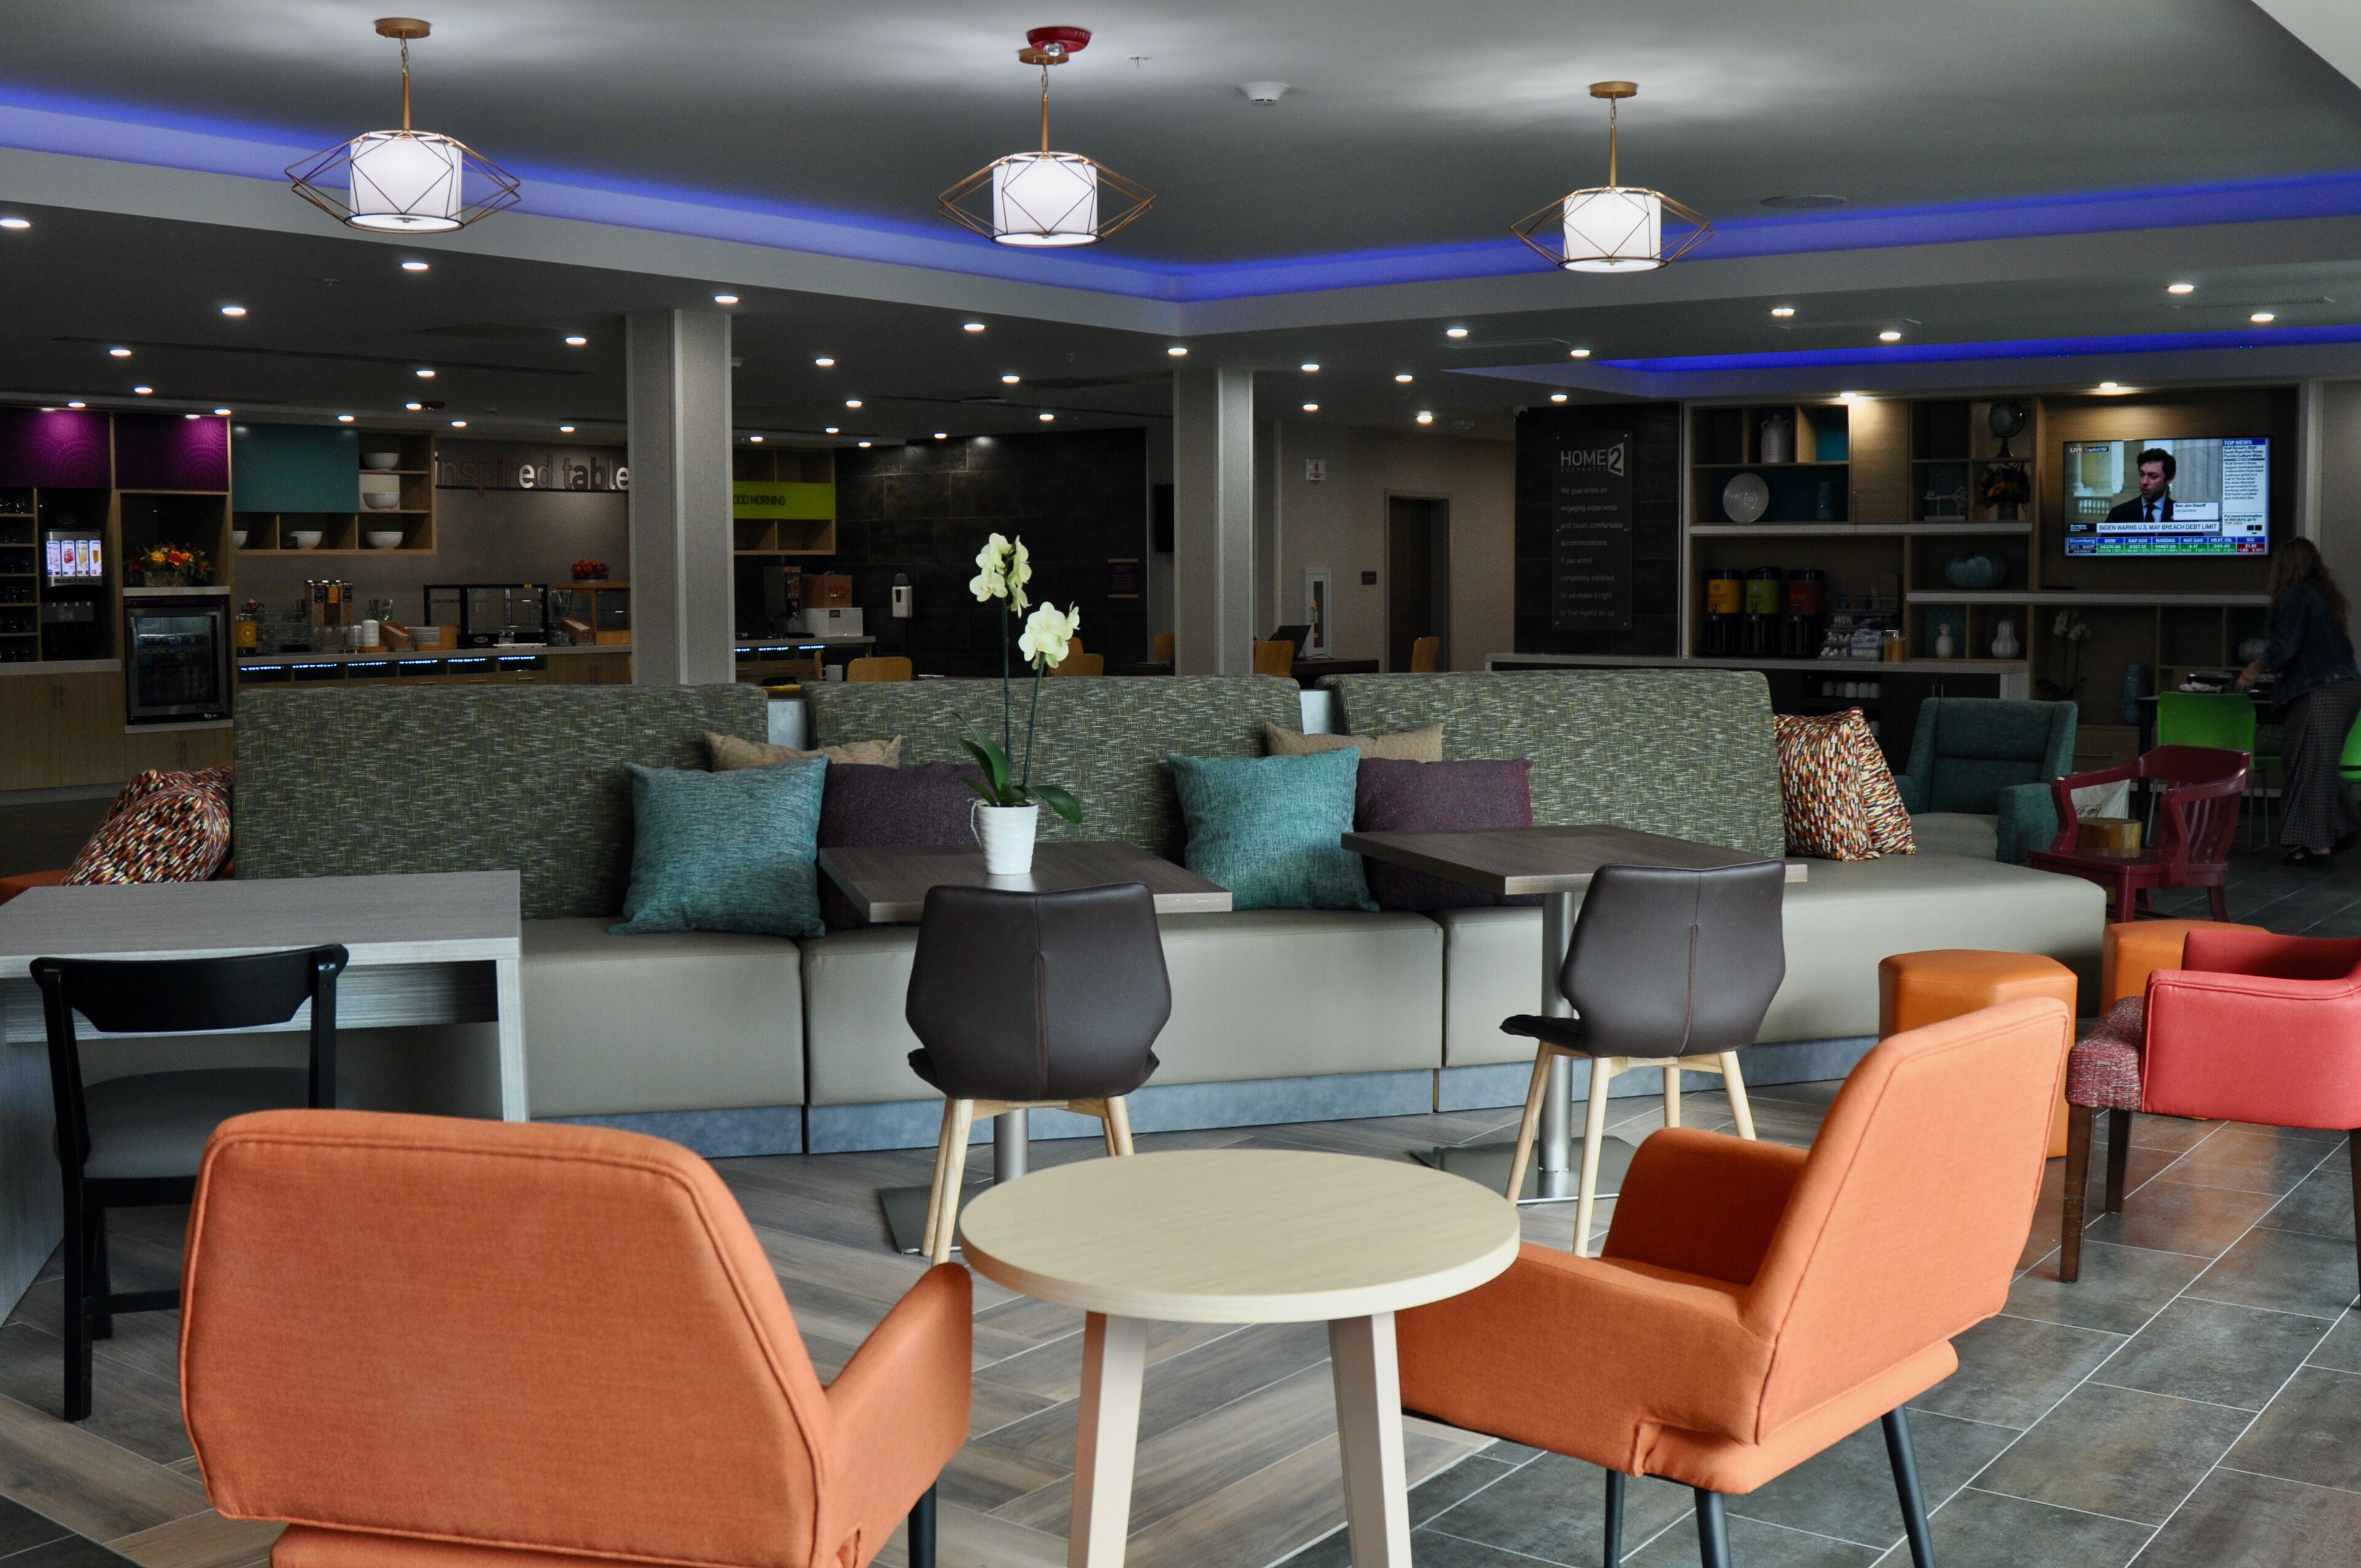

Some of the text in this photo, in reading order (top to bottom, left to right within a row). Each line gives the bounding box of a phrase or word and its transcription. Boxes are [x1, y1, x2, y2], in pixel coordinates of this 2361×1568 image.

[434, 451, 628, 497] inspired table
[733, 494, 786, 505] OOD MORNING
